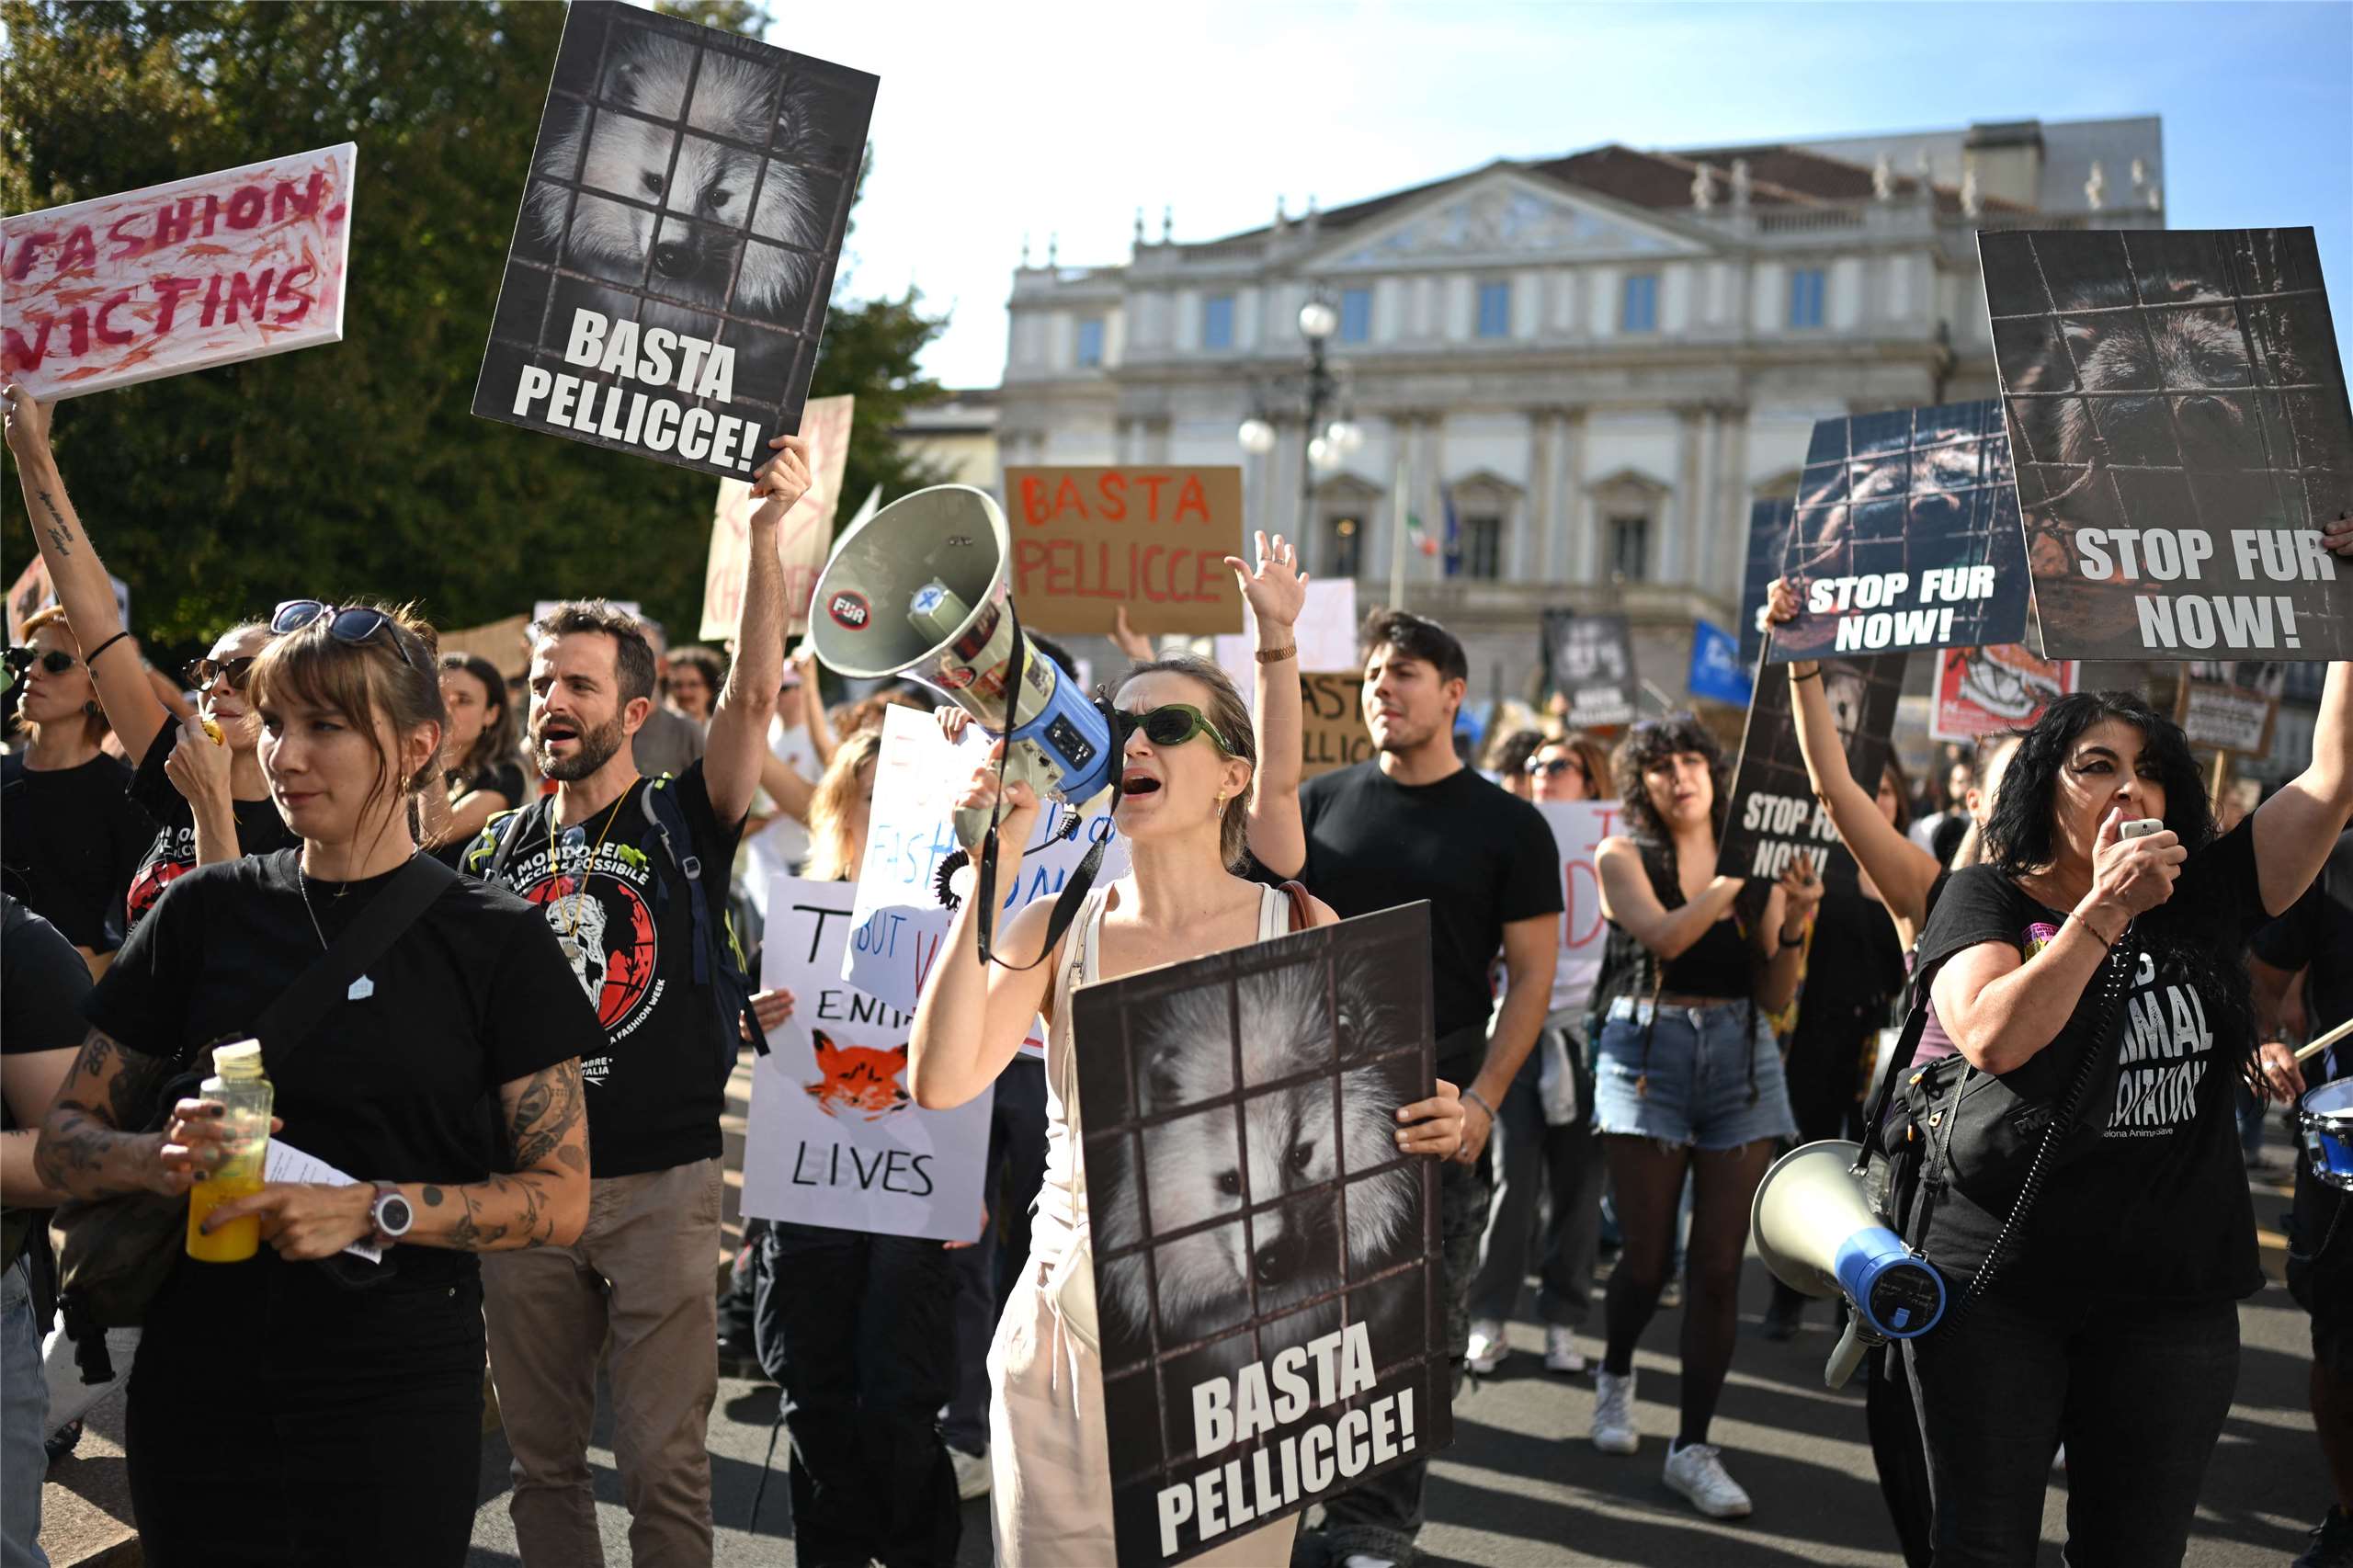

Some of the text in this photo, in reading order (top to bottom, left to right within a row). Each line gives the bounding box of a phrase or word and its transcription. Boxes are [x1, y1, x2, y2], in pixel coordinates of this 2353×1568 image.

[9, 173, 324, 280] FASHION
[0, 265, 314, 372] VICTIMS
[564, 308, 735, 403] BASTA
[513, 364, 761, 472] PELLICCE!
[1020, 472, 1211, 527] BASTA
[1016, 538, 1229, 603] PELLICCE
[2075, 528, 2336, 581] STOP FUR
[833, 597, 866, 624] FUR
[1808, 565, 1996, 614] STOP FUR
[1835, 608, 1955, 652] NOW!
[2135, 595, 2302, 649] NOW!
[1301, 674, 1364, 723] AST
[1743, 791, 1845, 843] STOP FU
[857, 908, 907, 958] BUT
[617, 1006, 653, 1040] FASHION
[648, 979, 665, 1006] WEEK
[581, 1057, 608, 1069] MBRE
[581, 1066, 609, 1077] TALIA
[792, 1141, 934, 1196] LIVES
[1192, 1321, 1377, 1459] BASTA
[1157, 1387, 1415, 1558] PELLICCE!
